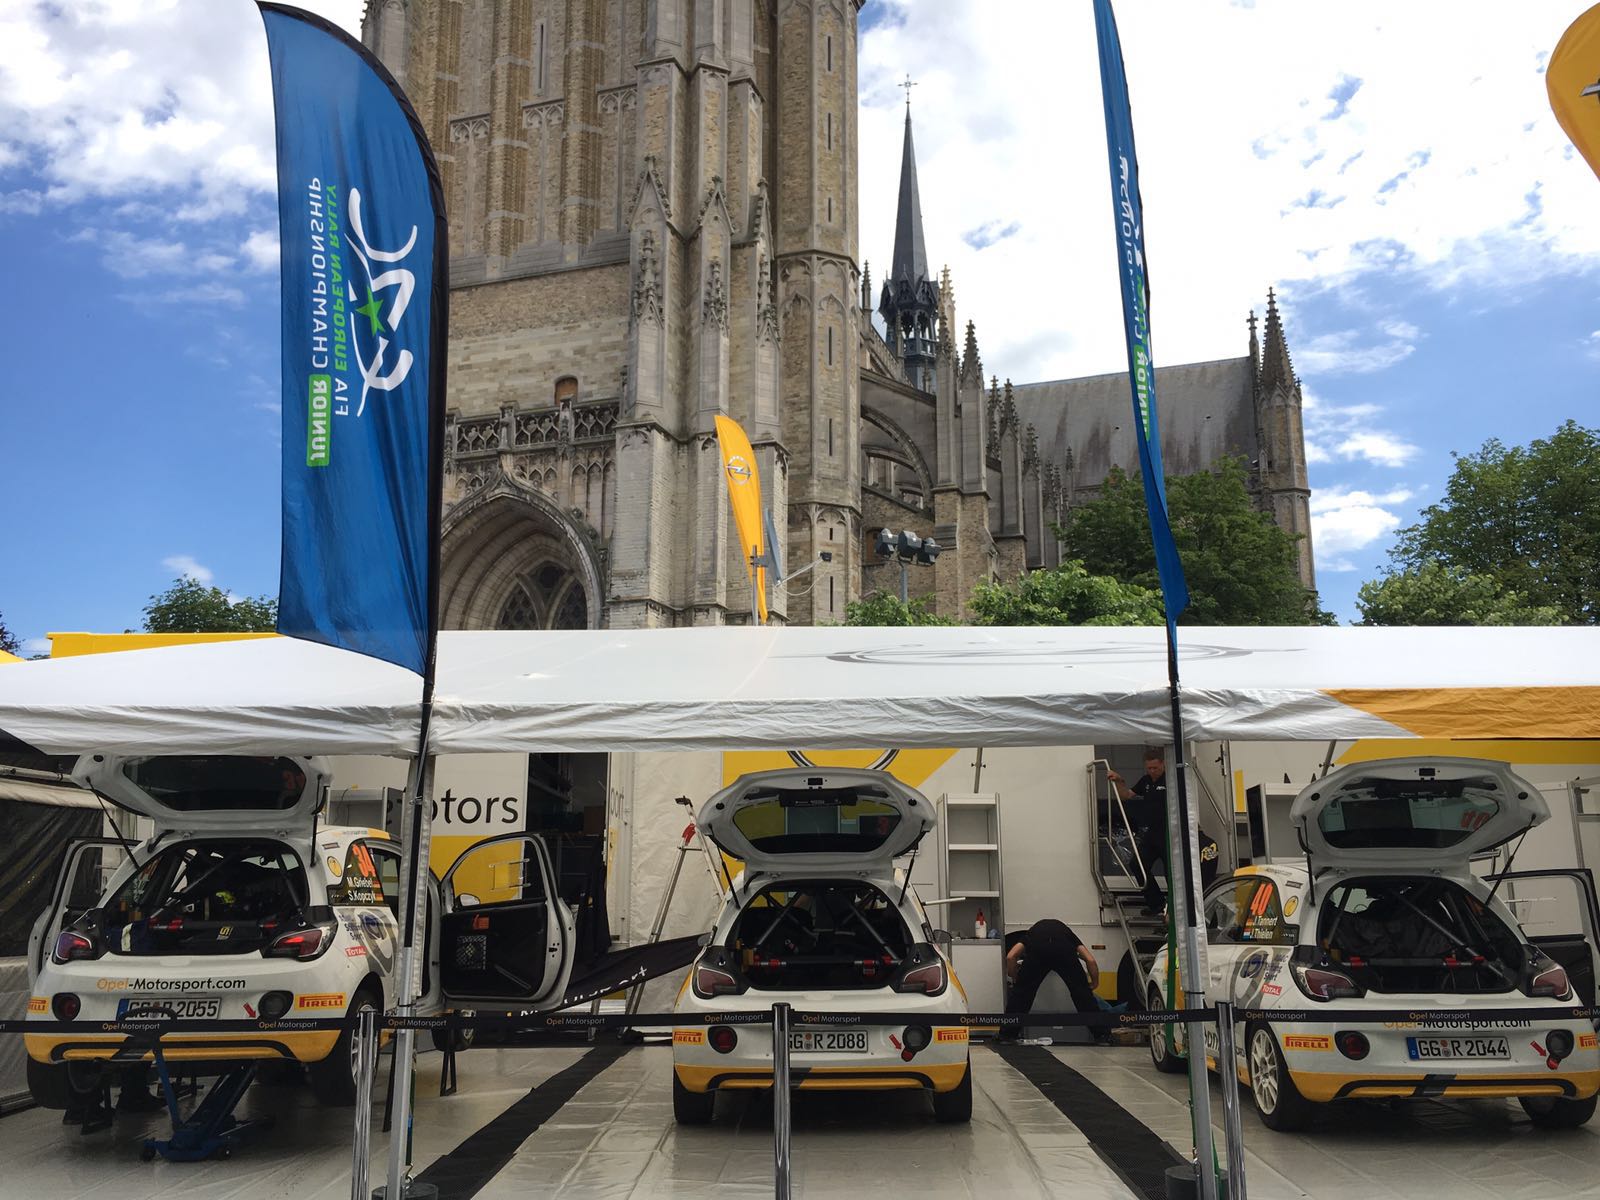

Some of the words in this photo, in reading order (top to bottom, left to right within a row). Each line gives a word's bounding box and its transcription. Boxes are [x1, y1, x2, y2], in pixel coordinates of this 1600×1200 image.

[352, 843, 376, 877] 34
[1250, 882, 1273, 916] 40
[346, 947, 366, 956] TOTAL
[96, 977, 246, 992] Opel-Motorsport.com
[1263, 984, 1281, 995] TOTAL
[299, 995, 343, 1008] PIRELLI
[176, 1000, 218, 1018] 2055
[1572, 1008, 1591, 1017] Opel
[704, 1014, 722, 1023] Opel
[724, 1013, 763, 1022] Motorsport
[802, 1014, 820, 1023] Opel
[821, 1015, 861, 1023] Motorsport
[960, 1016, 979, 1024] Opel
[979, 1016, 1019, 1024] Motorsport
[1119, 1014, 1138, 1022] Opel
[1138, 1013, 1179, 1021] Motorsport
[1245, 1011, 1264, 1020] Opel
[1265, 1011, 1306, 1020] Motorsport
[1409, 1011, 1428, 1020] Opel
[1430, 1012, 1470, 1020] Motorsport
[259, 1021, 277, 1030] Opel
[278, 1021, 317, 1029] Motorsport
[388, 1018, 406, 1027] Opel
[407, 1019, 447, 1027] Motorsport
[546, 1017, 564, 1026] Opel
[565, 1017, 606, 1026] Motorsport
[102, 1022, 120, 1031] Opel
[121, 1023, 160, 1031] Motorsport
[814, 1034, 823, 1049] R
[827, 1033, 866, 1049] 2088
[1286, 1036, 1329, 1049] PIRELLI
[1418, 1040, 1442, 1056] GG
[1451, 1040, 1463, 1056] R
[1465, 1040, 1508, 1056] 2044
